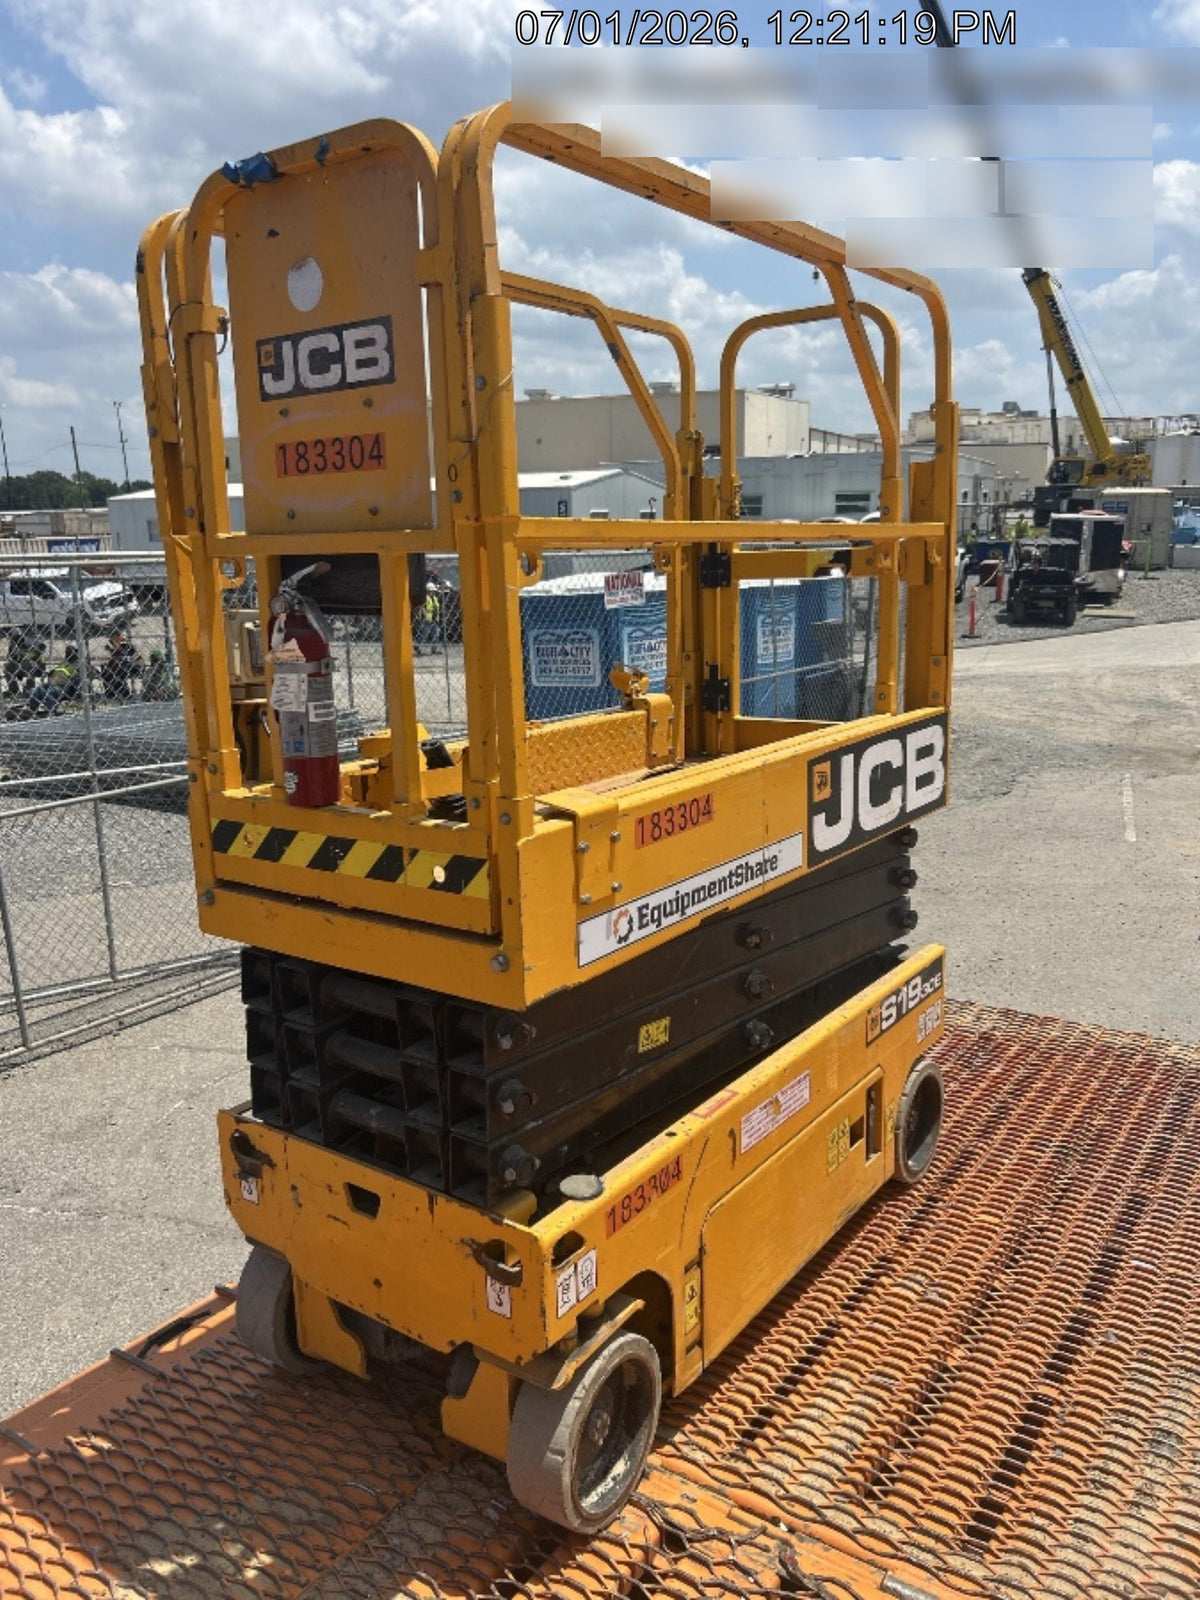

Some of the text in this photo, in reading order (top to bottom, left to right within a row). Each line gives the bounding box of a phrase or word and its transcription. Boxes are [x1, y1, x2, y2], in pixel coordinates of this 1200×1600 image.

[262, 324, 391, 395] JCB
[278, 433, 384, 475] 183304
[637, 793, 713, 846] 183304
[813, 724, 946, 853] JCB
[636, 854, 779, 929] EquipmentShare
